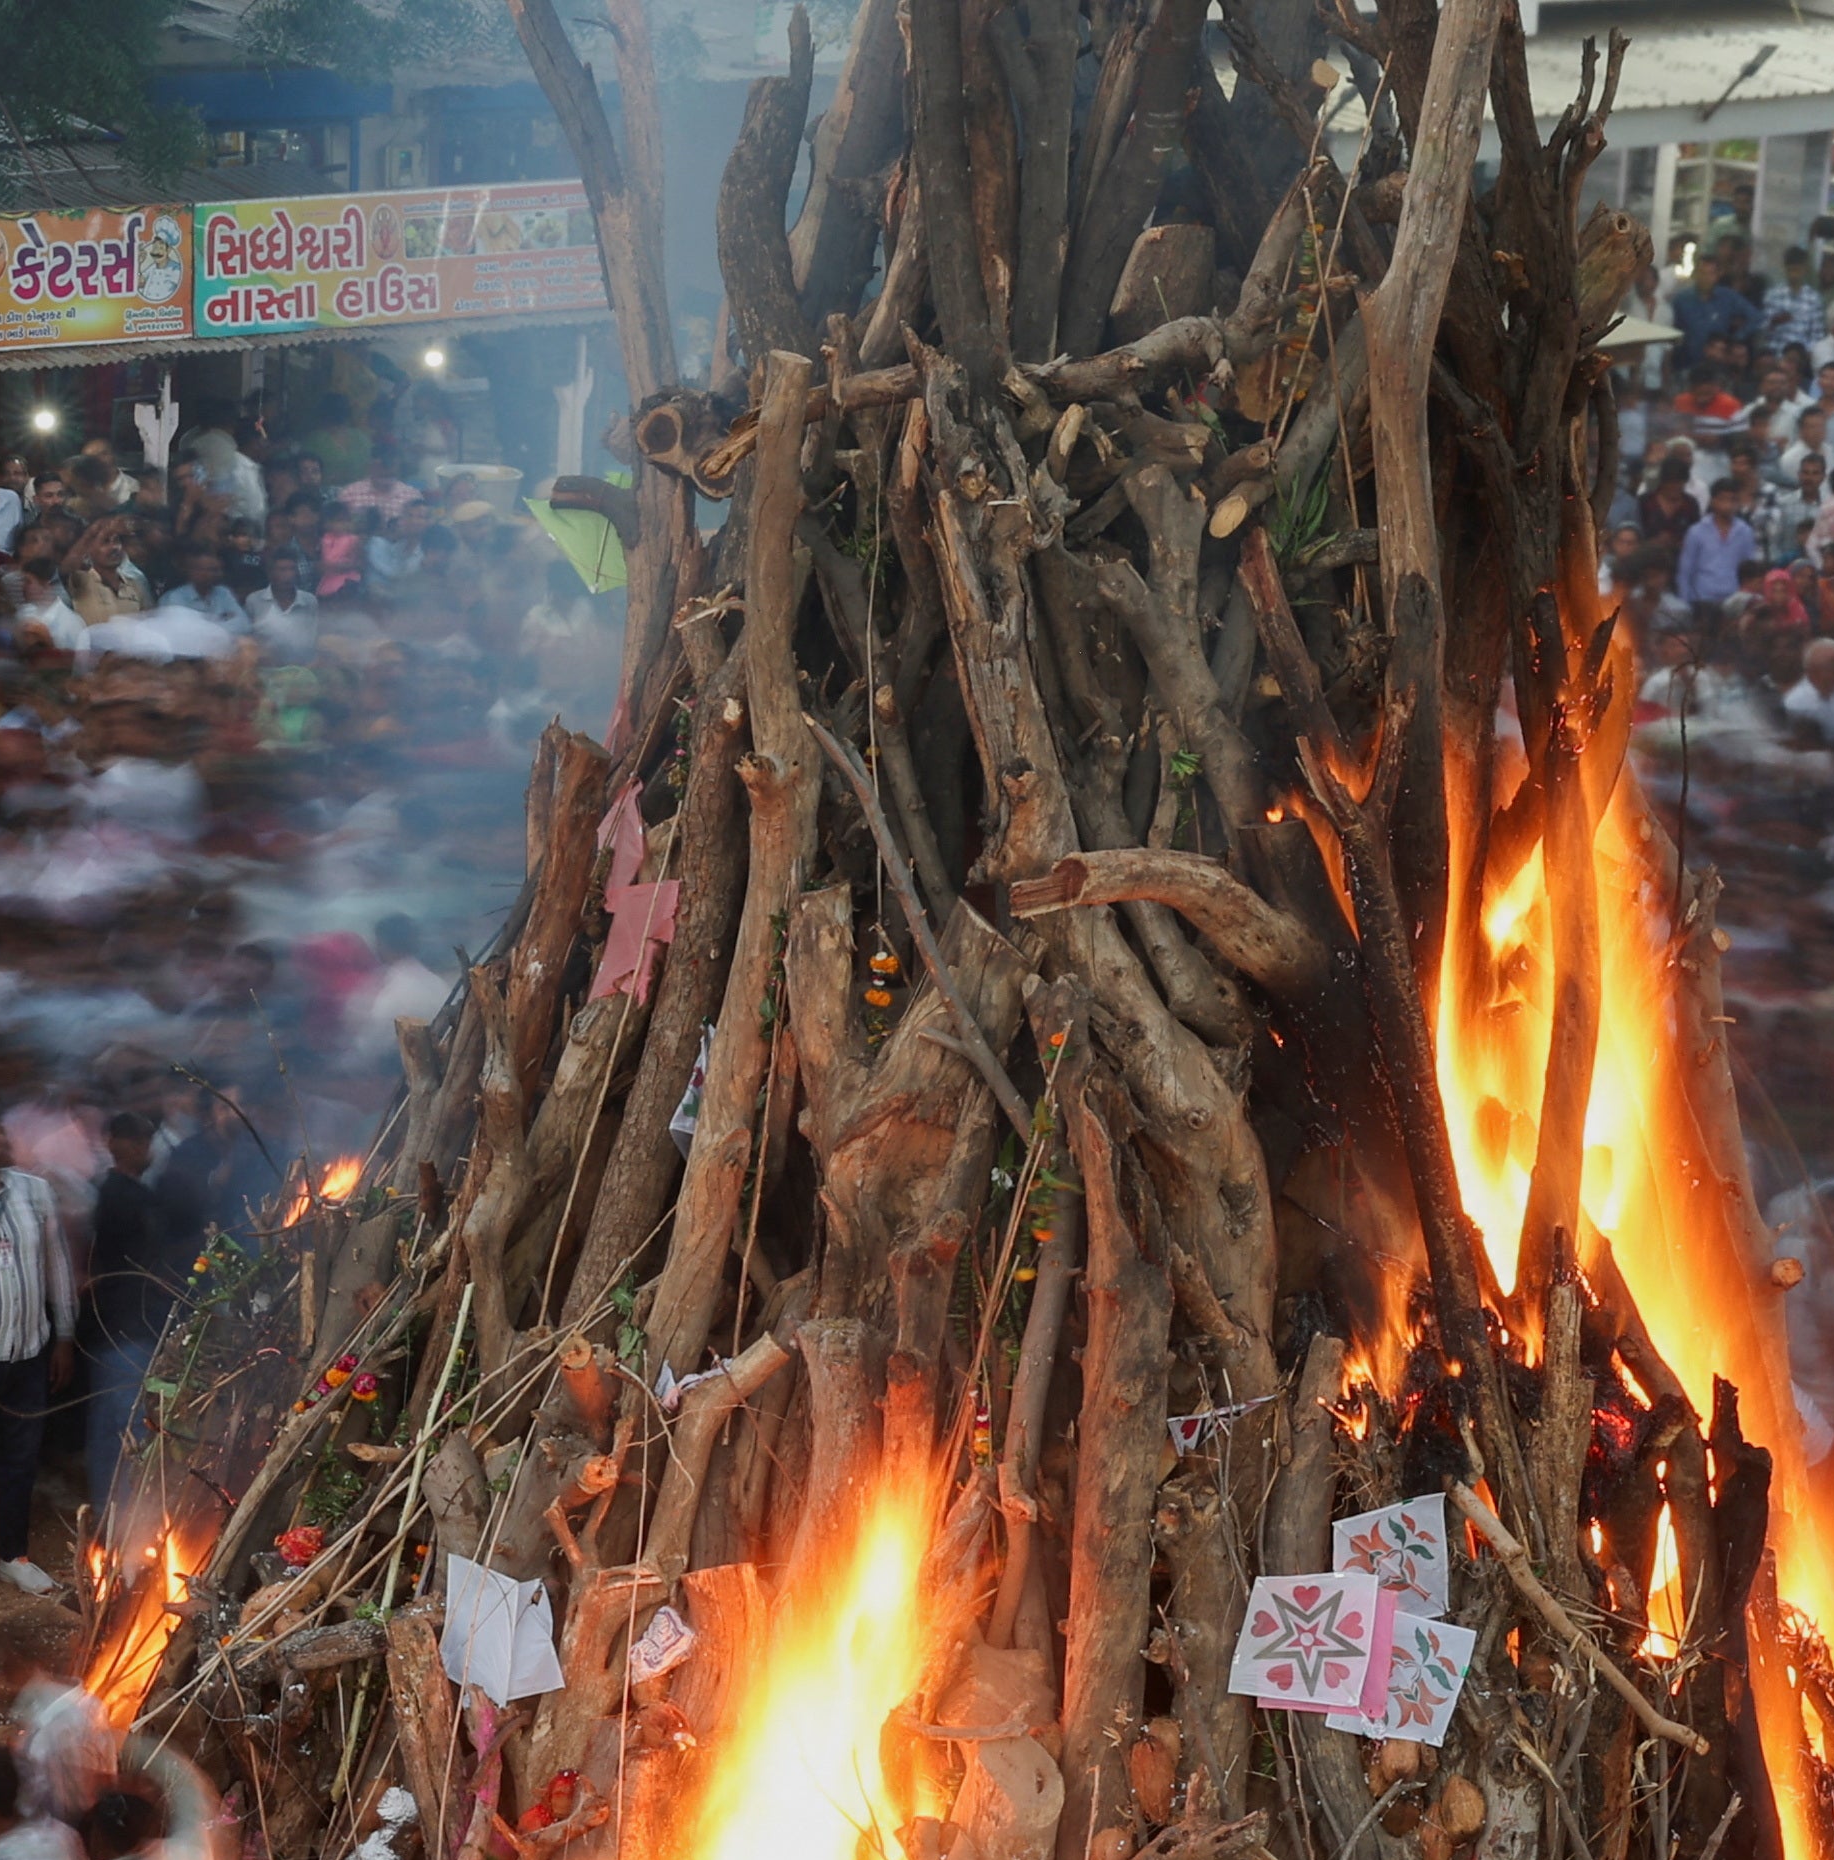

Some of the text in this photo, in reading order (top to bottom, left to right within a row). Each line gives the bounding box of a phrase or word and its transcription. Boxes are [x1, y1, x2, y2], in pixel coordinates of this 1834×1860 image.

[11, 219, 142, 299] કેટરર્સ
[207, 284, 315, 323] નાસ્તા
[336, 267, 440, 316] હાઉસ
